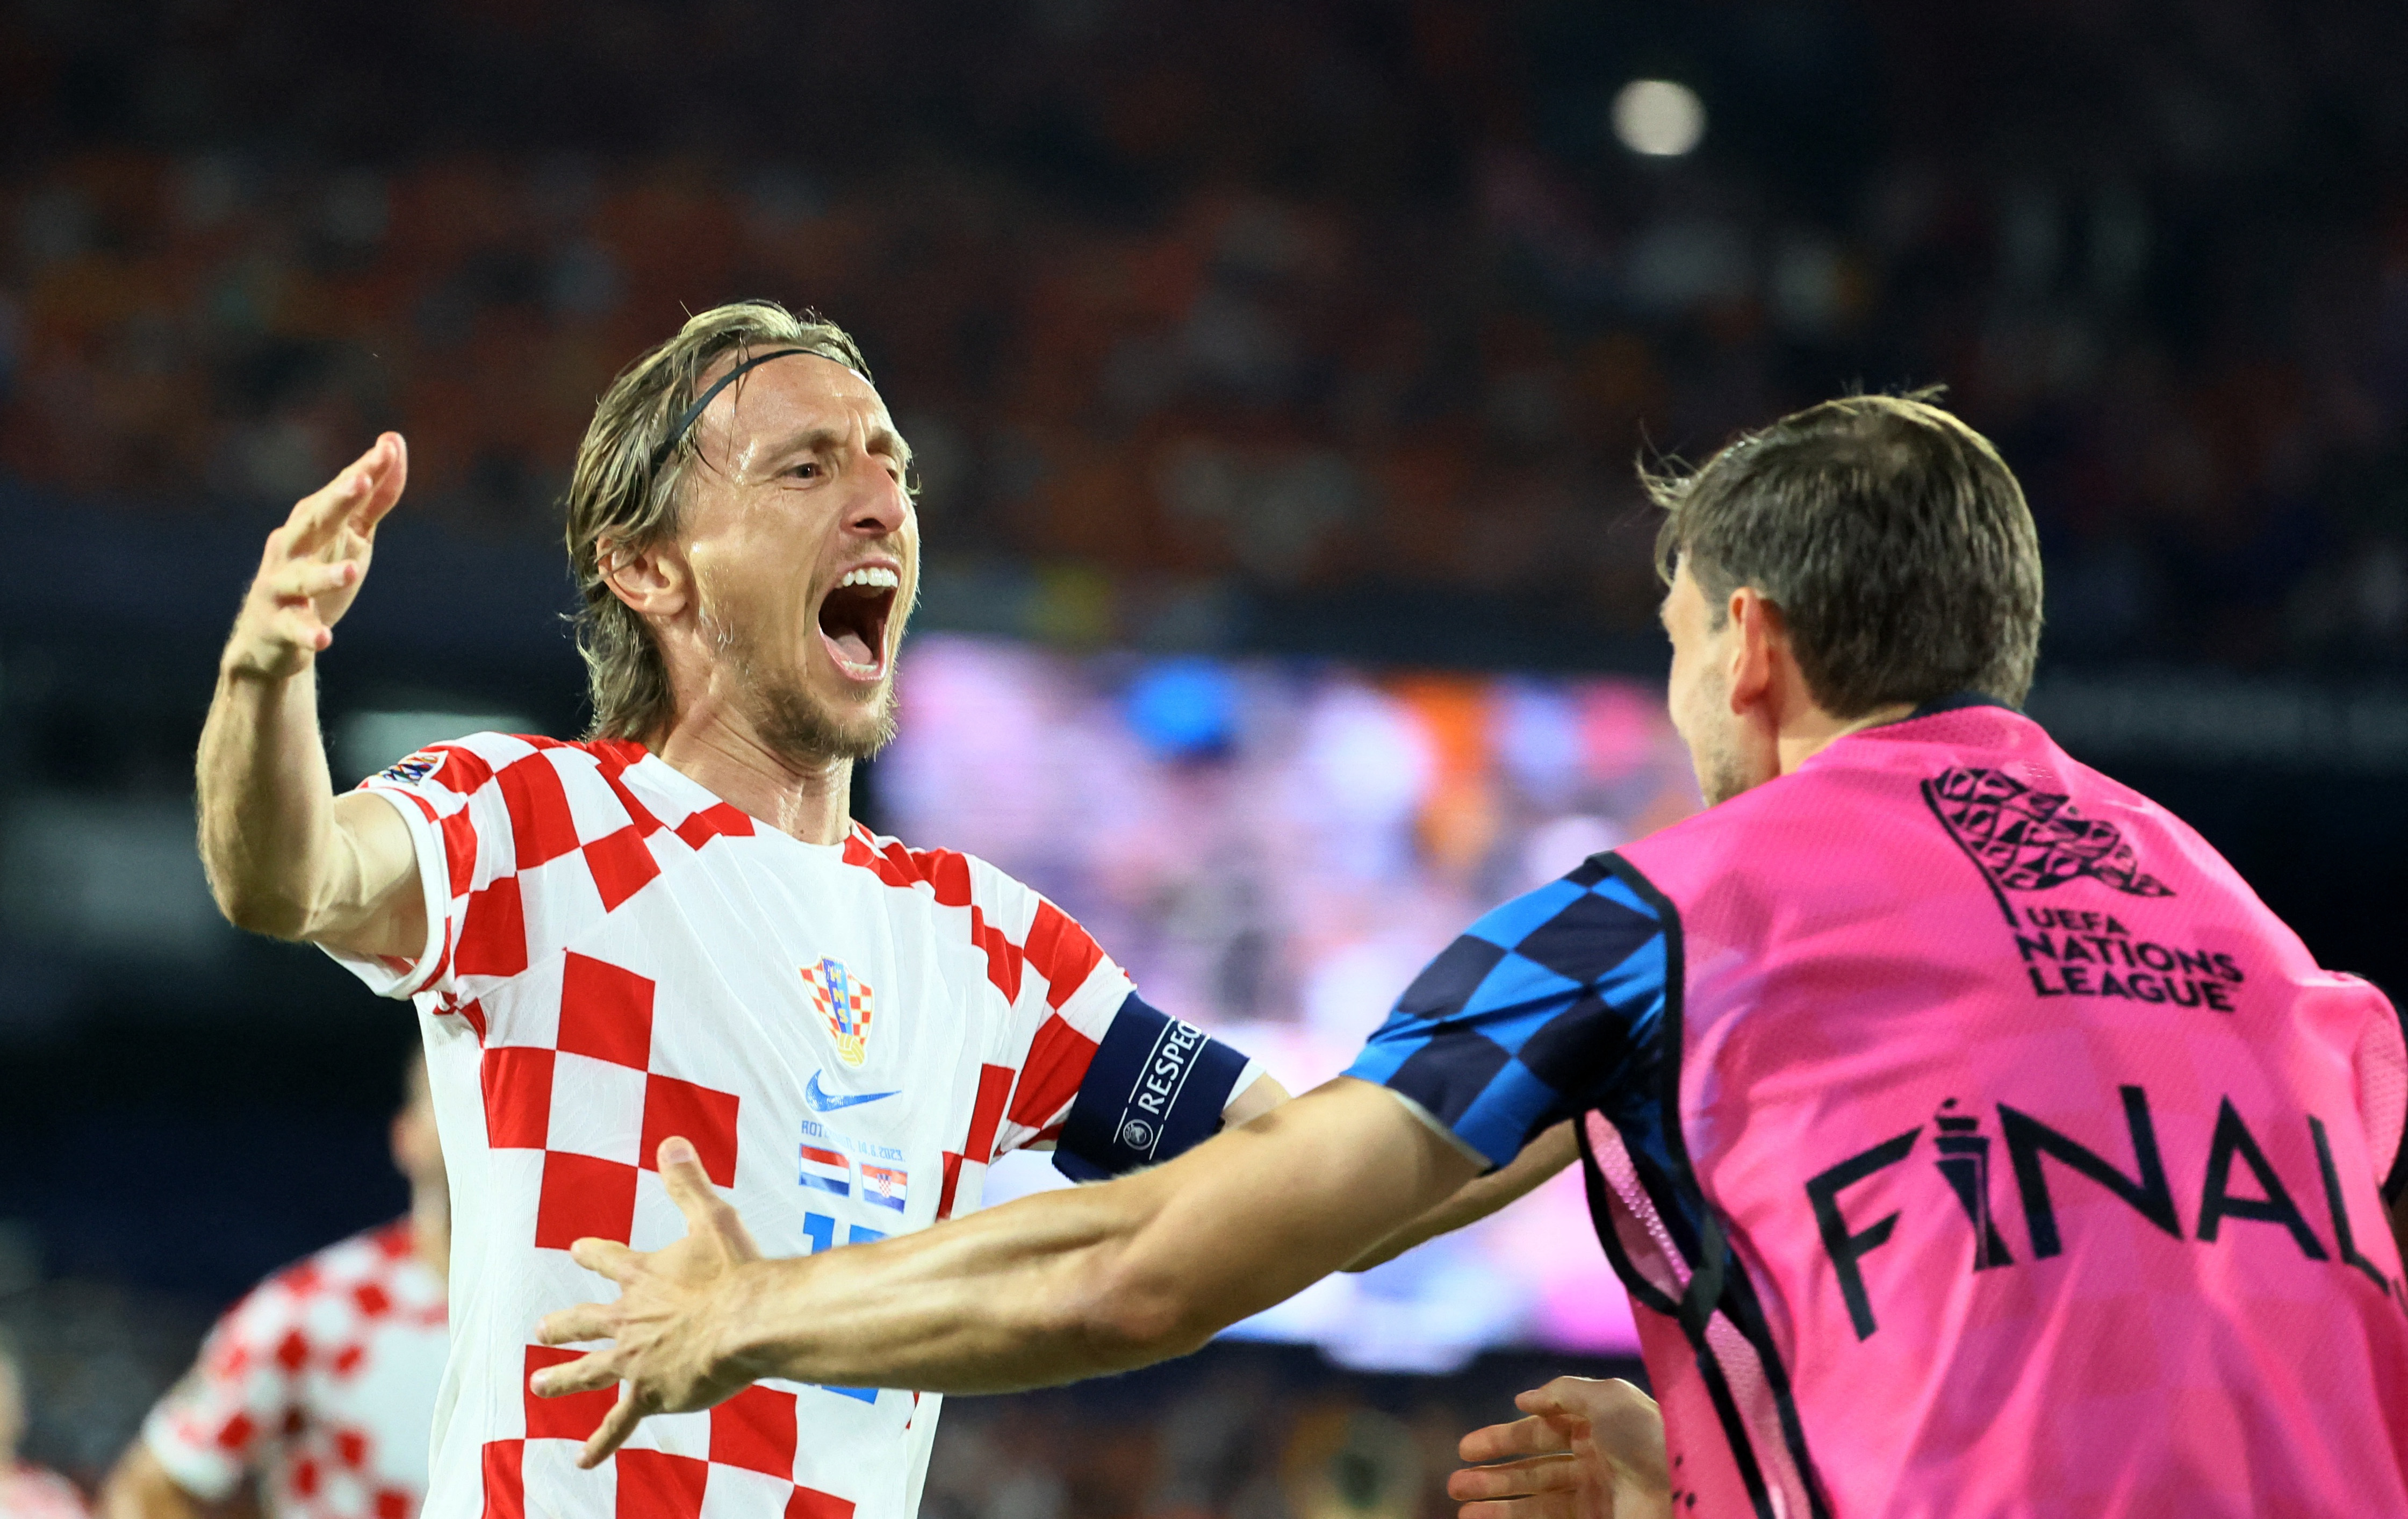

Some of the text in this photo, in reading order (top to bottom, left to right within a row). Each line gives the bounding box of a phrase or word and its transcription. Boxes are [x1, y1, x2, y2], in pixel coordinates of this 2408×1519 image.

[2026, 908, 2131, 936] UEFA
[2014, 933, 2244, 983] NATIONS
[829, 968, 849, 1024] HNS
[2029, 966, 2235, 1013] LEAGUE
[1138, 1019, 1202, 1115] RESPEC
[1804, 1085, 2408, 1342] FINAL
